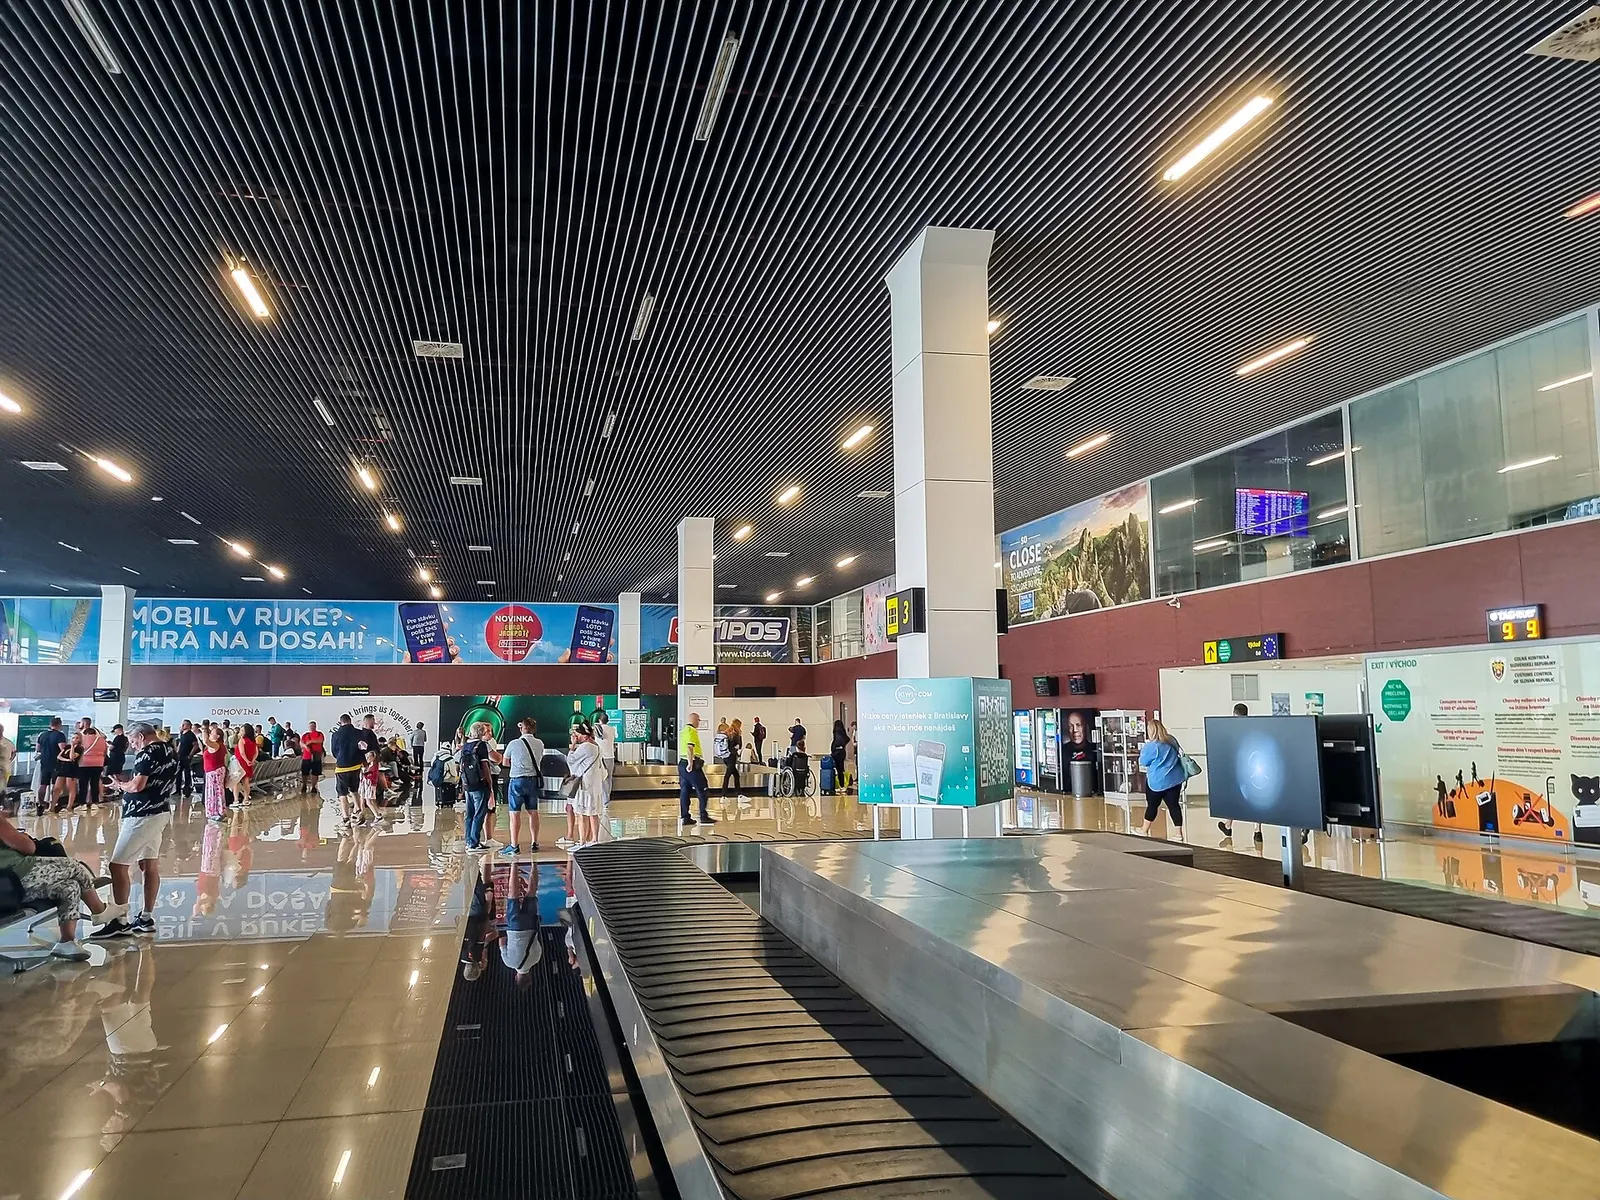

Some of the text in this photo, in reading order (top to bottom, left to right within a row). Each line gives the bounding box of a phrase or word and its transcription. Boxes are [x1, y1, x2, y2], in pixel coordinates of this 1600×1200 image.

[1020, 535, 1028, 545] SO
[1009, 543, 1042, 569] CLOSE
[132, 606, 342, 626] MOBIL V RUKE?
[902, 600, 909, 624] 3
[1502, 619, 1538, 640] 9 9
[132, 630, 364, 650] HRA NA DOSAH!
[717, 650, 772, 659] www.tipos.sk
[1389, 660, 1417, 668] VÝCHOD
[353, 705, 378, 716] brings
[378, 705, 388, 714] us
[933, 712, 969, 721] Bratislavy
